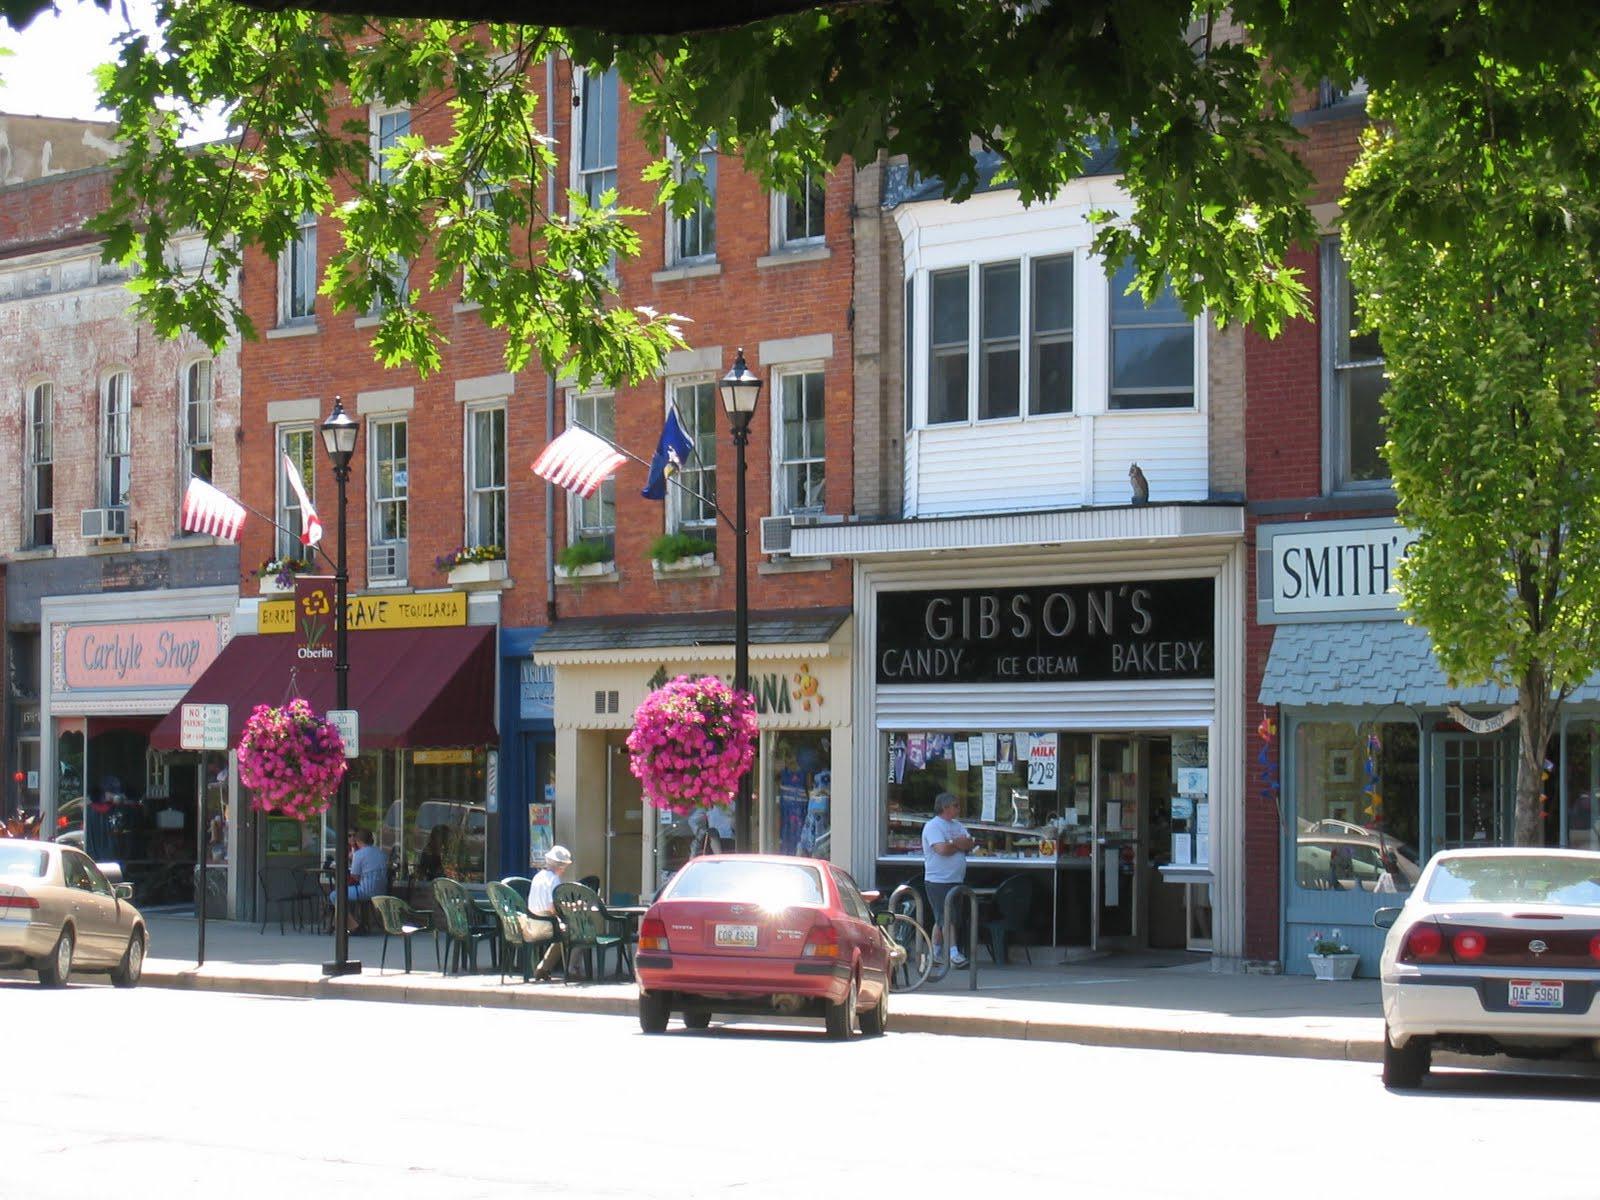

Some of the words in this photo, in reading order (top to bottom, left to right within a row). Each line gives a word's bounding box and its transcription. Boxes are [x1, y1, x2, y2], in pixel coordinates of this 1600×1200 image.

[399, 602, 458, 618] TEQUILARIA
[924, 586, 1152, 640] GIBSON'S
[82, 632, 143, 679] Carlyle
[155, 629, 200, 674] Shop
[297, 647, 333, 660] Oberlin
[882, 648, 964, 677] CANDY
[997, 656, 1020, 675] ICE
[1026, 655, 1079, 674] CREAM
[1112, 640, 1204, 673] BAKERY
[189, 708, 200, 718] NO
[1030, 746, 1057, 758] MILK
